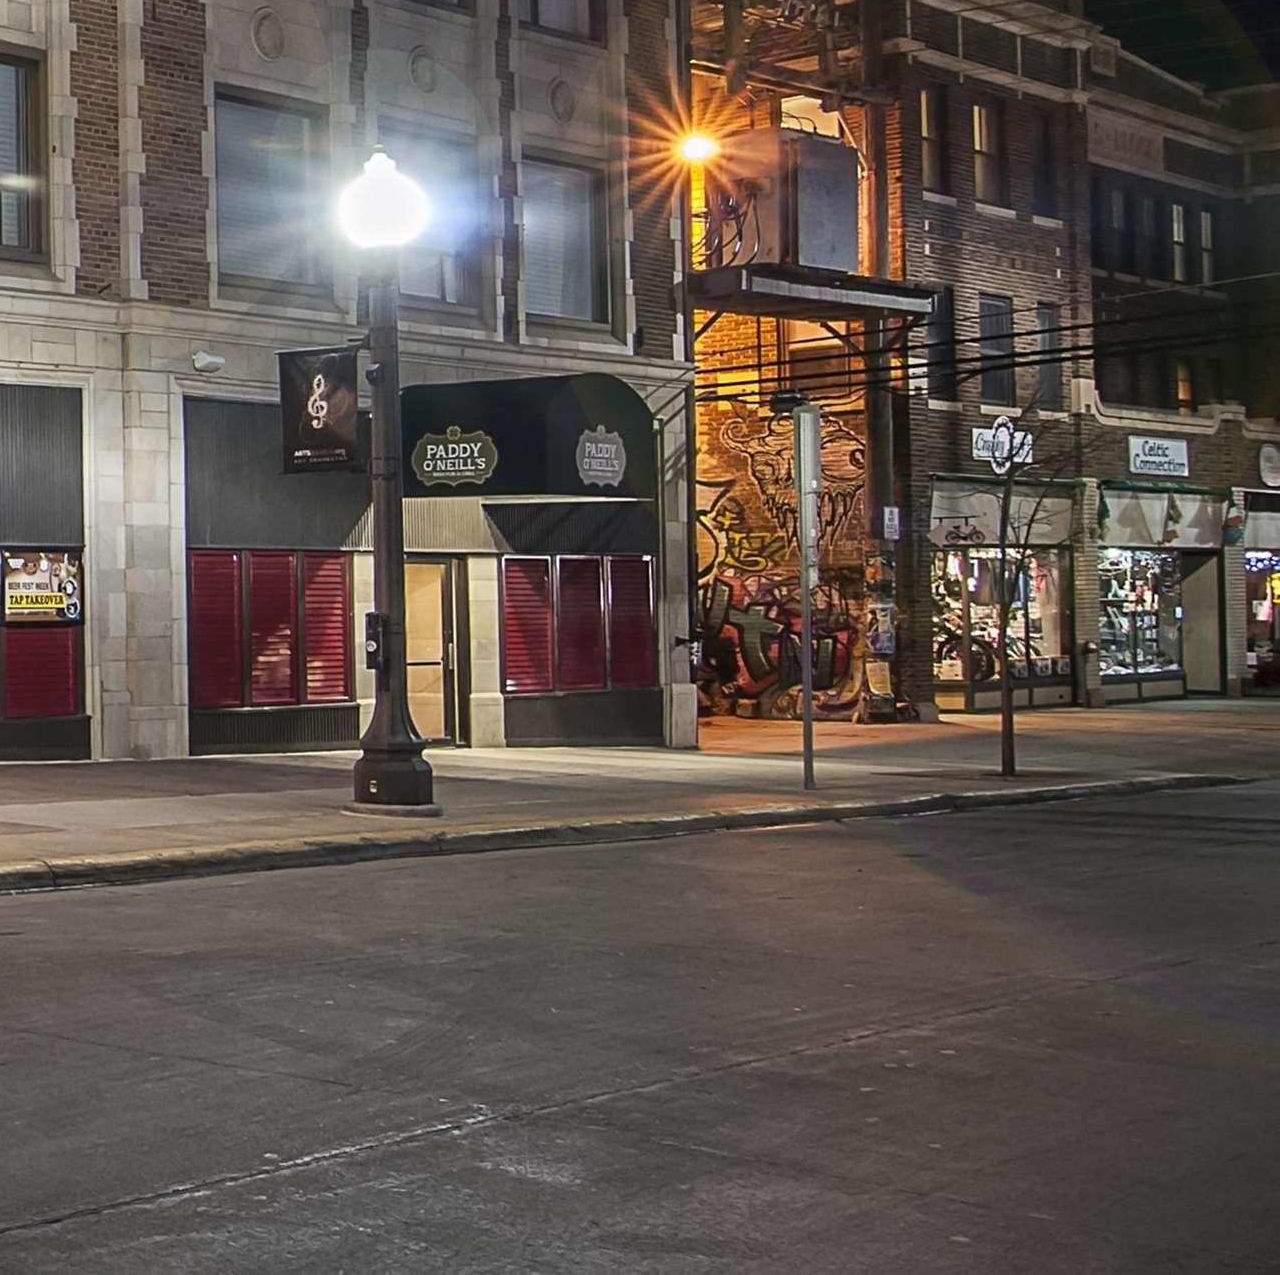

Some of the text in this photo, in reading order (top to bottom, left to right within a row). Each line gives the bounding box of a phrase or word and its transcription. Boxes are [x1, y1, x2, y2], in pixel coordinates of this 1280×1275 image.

[426, 442, 483, 459] PADDY
[584, 442, 617, 459] PADDY
[1141, 440, 1170, 458] Celtic
[423, 457, 487, 472] O'NEILL'S
[1133, 453, 1186, 474] Connection
[9, 595, 64, 606] TAP TAKEOVER
